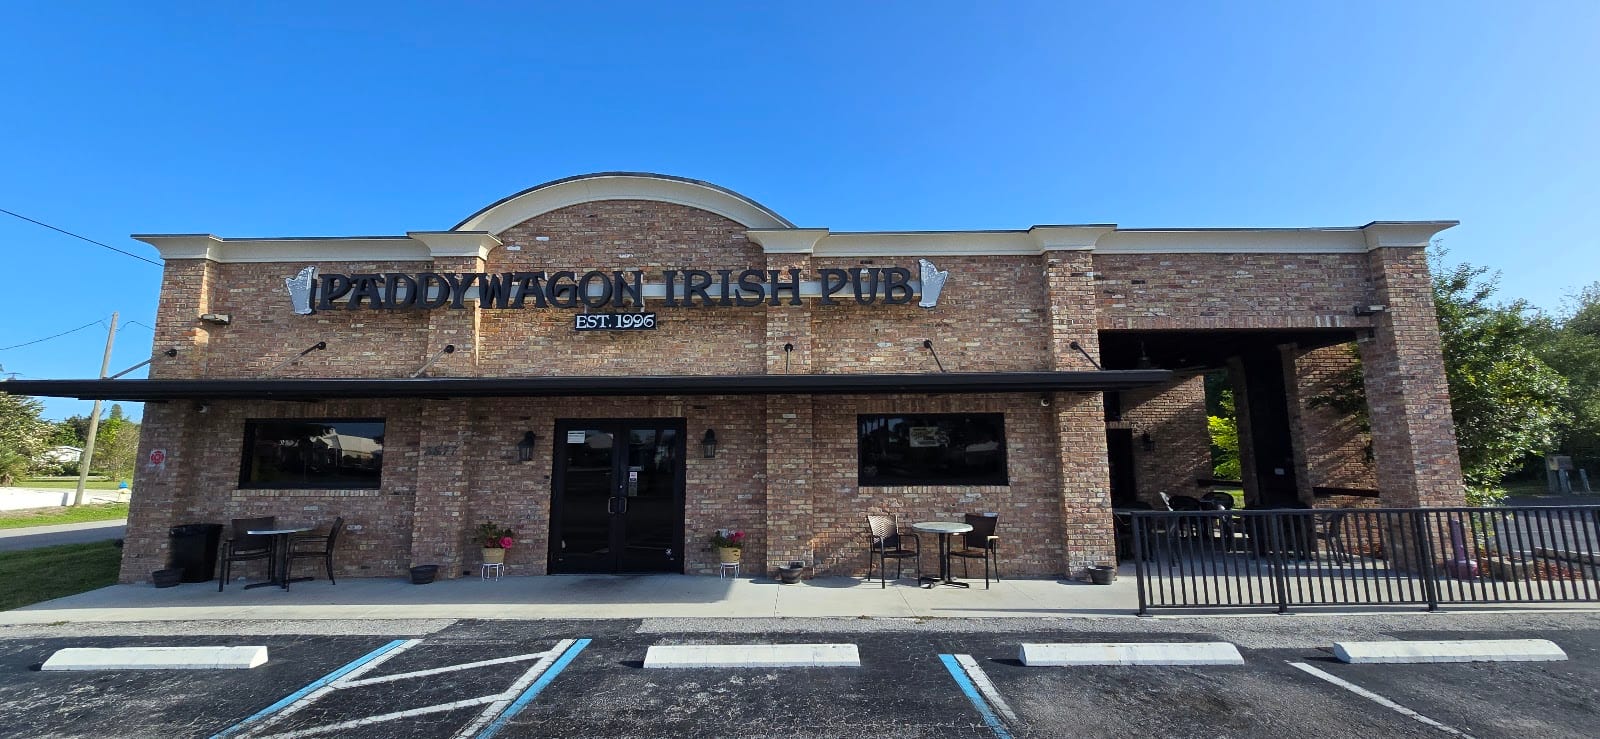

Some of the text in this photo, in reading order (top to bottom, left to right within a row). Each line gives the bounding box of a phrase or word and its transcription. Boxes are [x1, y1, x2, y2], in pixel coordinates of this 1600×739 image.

[317, 267, 914, 310] PADDYWAGON IRISH PUB
[576, 314, 655, 329] EST. 1996
